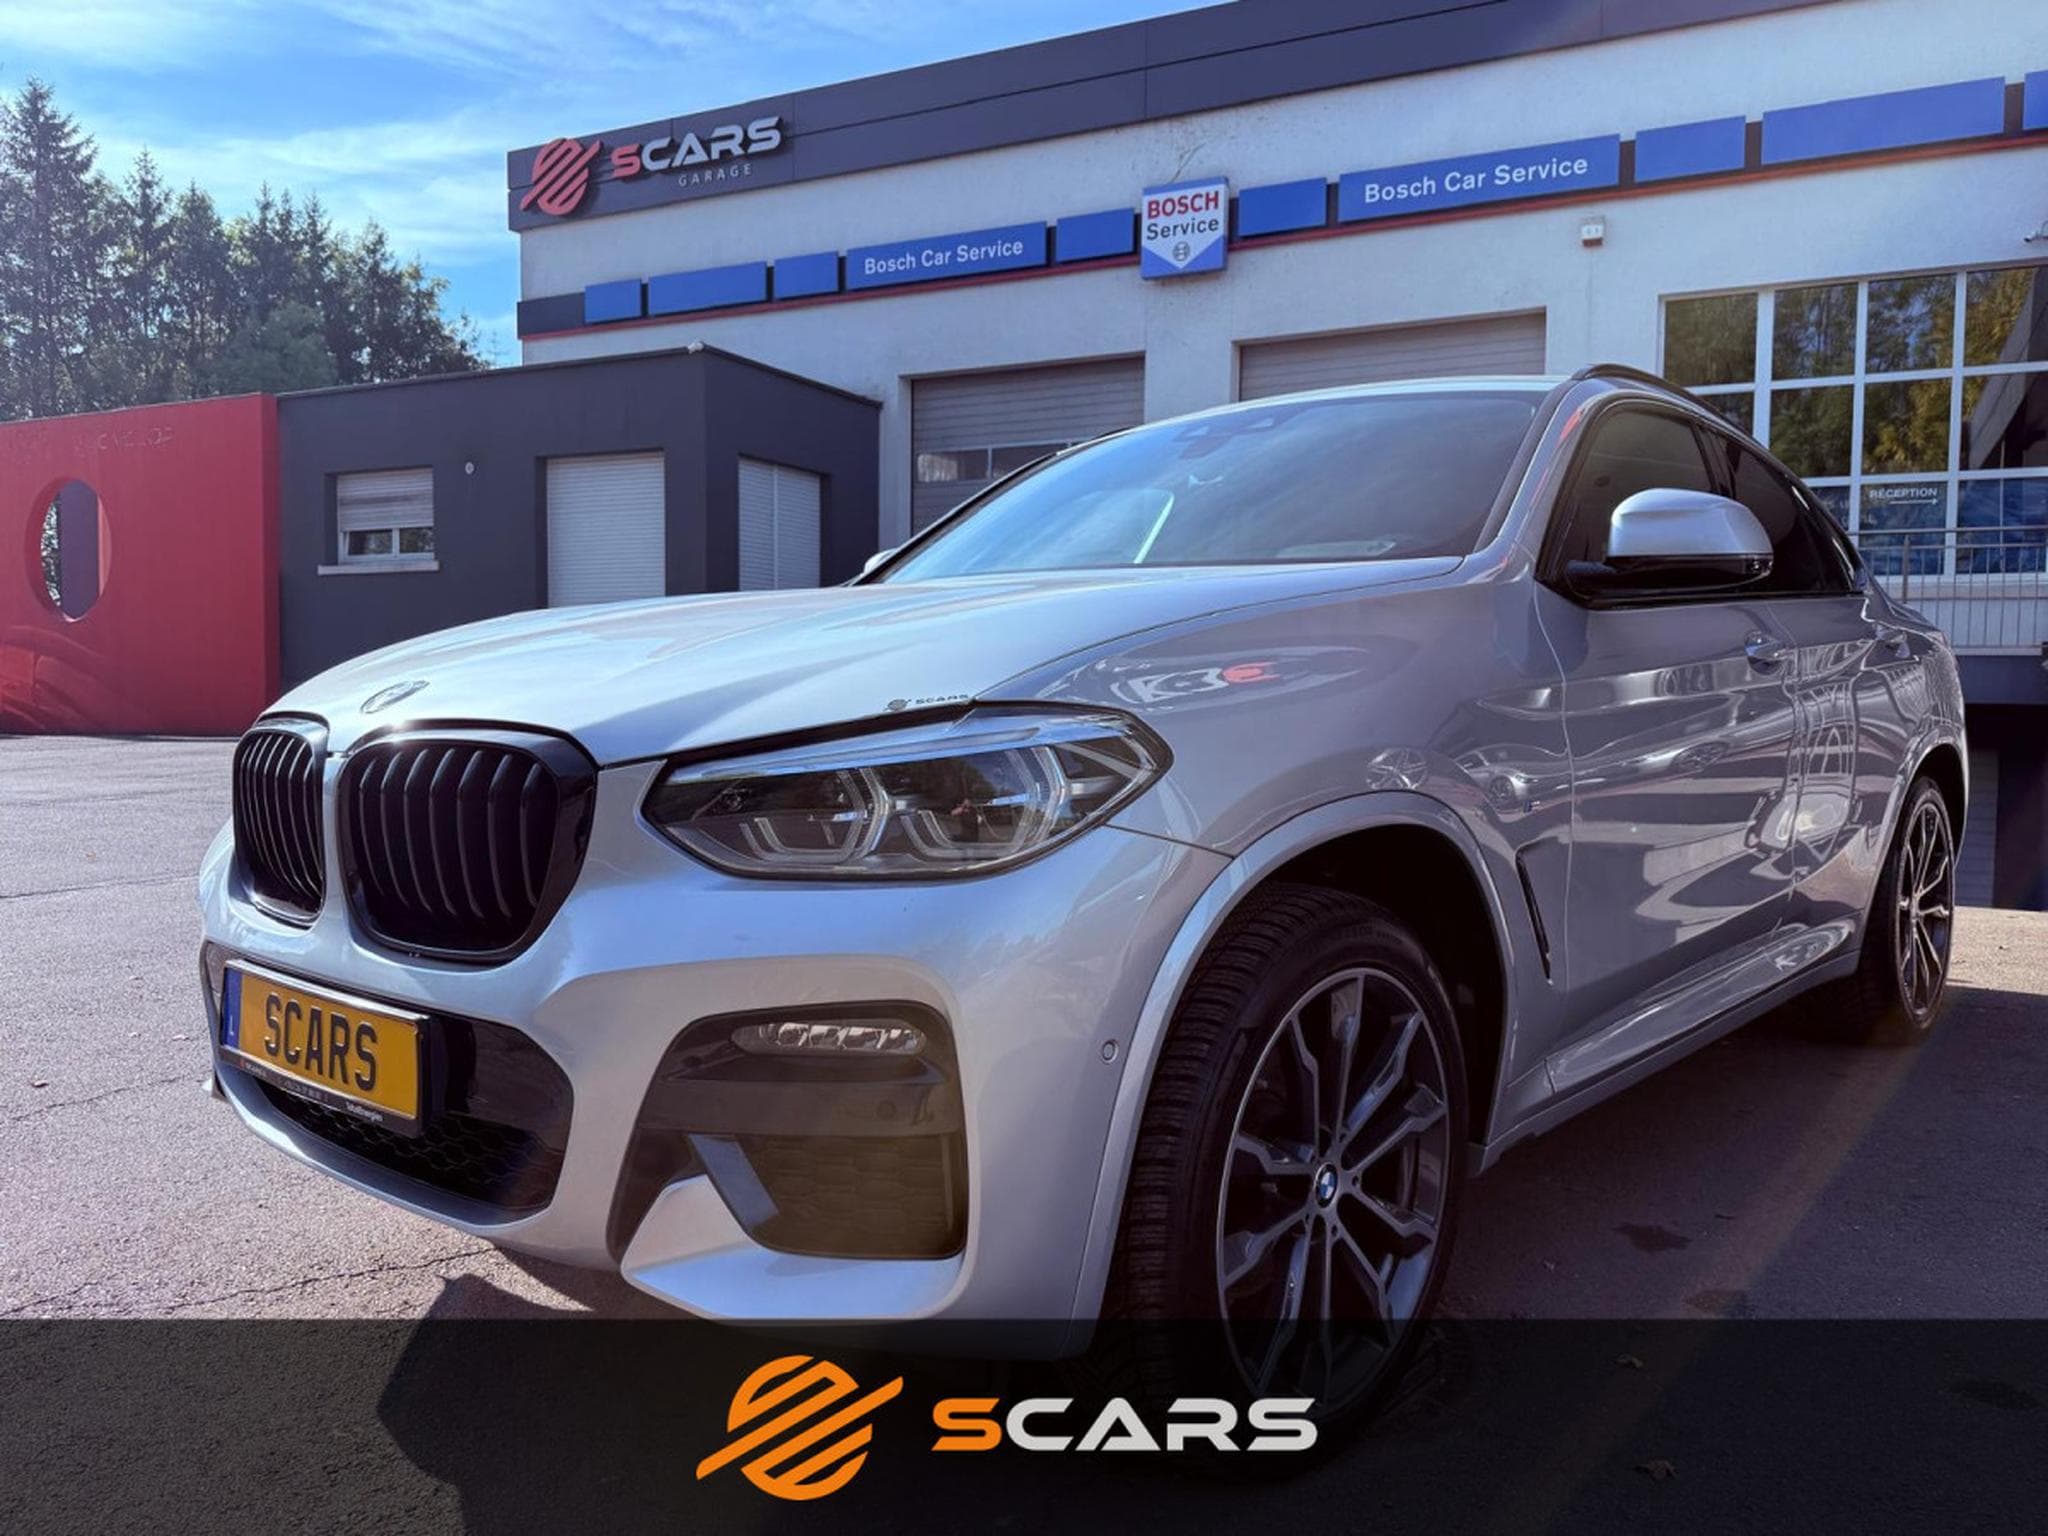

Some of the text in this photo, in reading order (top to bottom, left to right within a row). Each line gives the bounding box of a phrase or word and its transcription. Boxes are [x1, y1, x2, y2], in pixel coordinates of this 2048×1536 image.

[611, 116, 782, 178] SCARS
[678, 163, 752, 187] GARAGE
[1364, 158, 1588, 203] Bosch Car Service
[1147, 191, 1219, 219] BOSCH
[1146, 217, 1220, 241] Service
[864, 239, 1023, 275] Bosch Car Service
[263, 992, 378, 1091] SCARS
